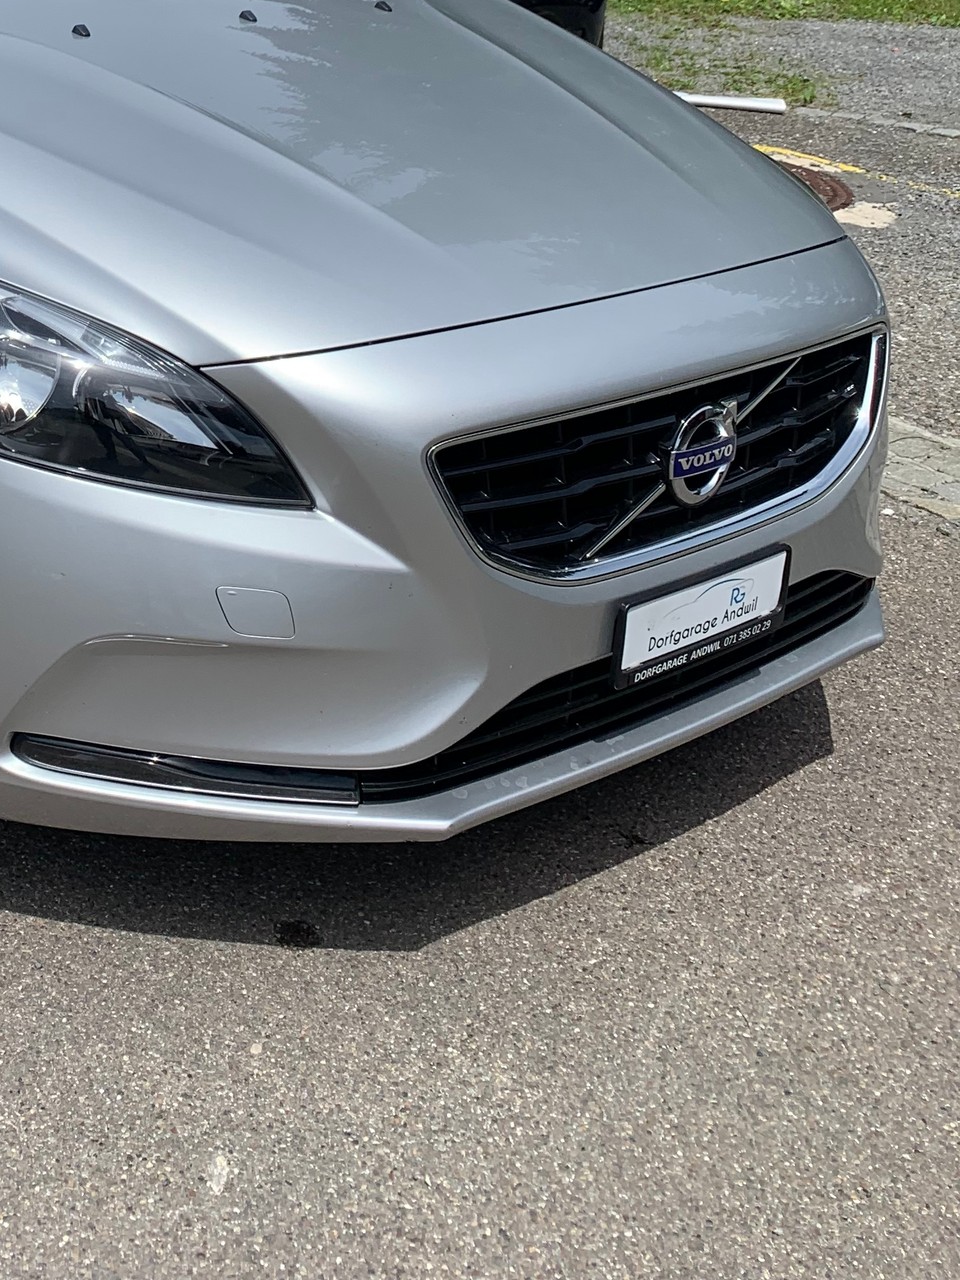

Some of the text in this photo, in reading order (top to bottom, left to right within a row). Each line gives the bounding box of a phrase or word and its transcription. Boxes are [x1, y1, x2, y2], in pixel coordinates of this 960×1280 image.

[678, 443, 733, 471] VOLVO
[633, 619, 771, 683] DORFGARAGE ANDWIL 071 385 02 29
[647, 596, 759, 652] Dorfgarage Andwil
